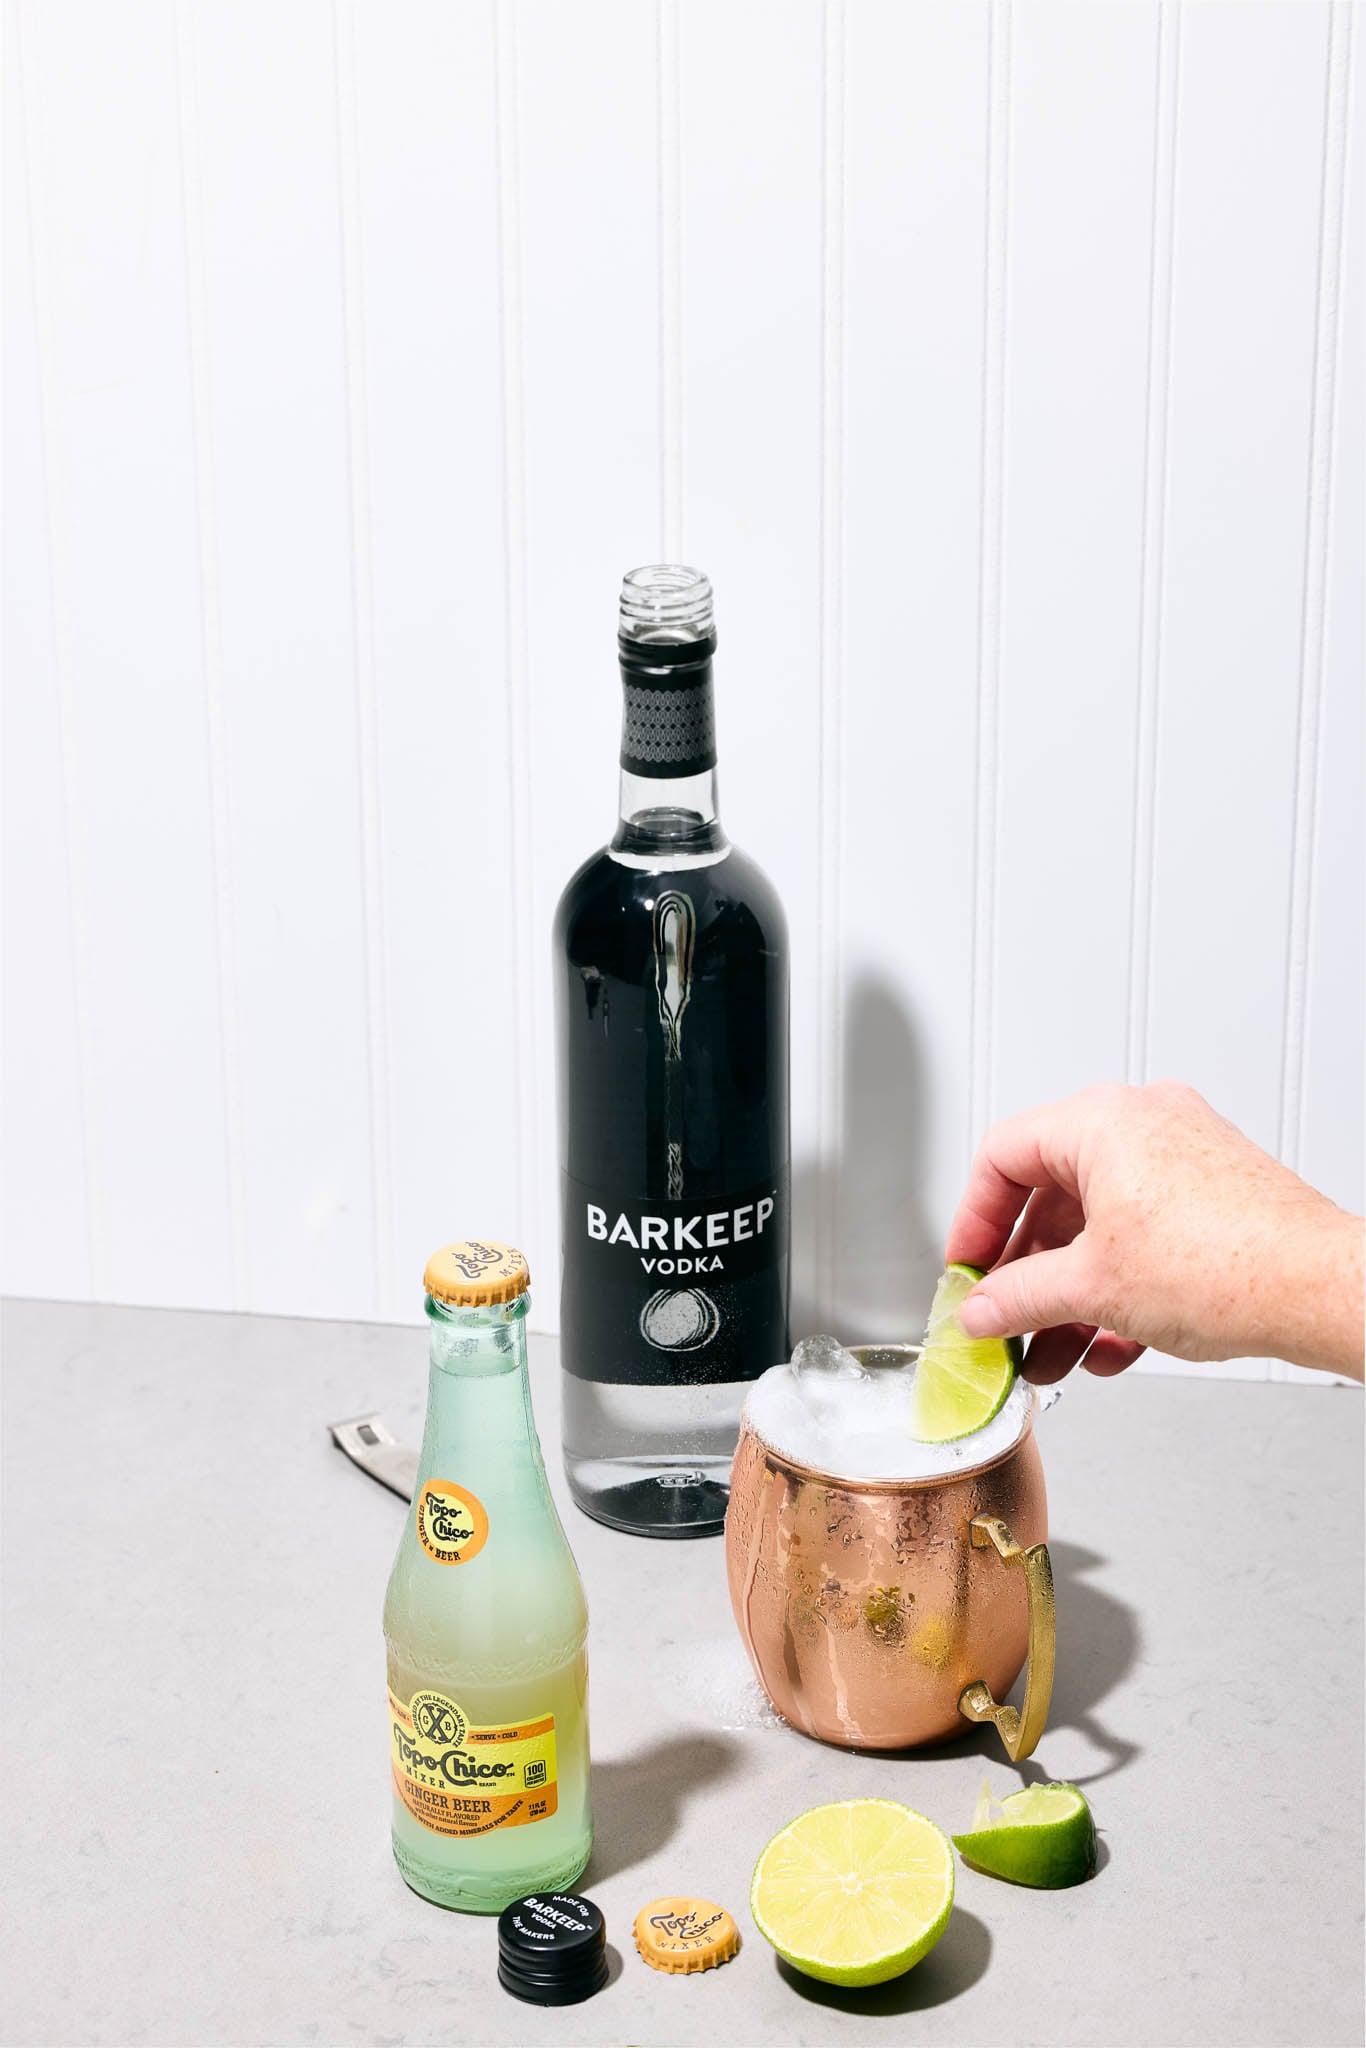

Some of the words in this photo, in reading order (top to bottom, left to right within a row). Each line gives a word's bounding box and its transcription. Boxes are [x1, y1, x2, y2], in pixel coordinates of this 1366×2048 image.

[586, 1196, 774, 1251] BARKEEP
[452, 1252, 488, 1279] Topo
[640, 1254, 724, 1275] VODKA
[425, 1492, 462, 1518] Topo
[418, 1504, 430, 1547] GINGER
[435, 1547, 461, 1561] BEER
[432, 1515, 474, 1541] Chico
[420, 1694, 432, 1702] THE
[433, 1695, 466, 1727] LEGENDARY
[453, 1729, 466, 1748] TASTE
[423, 1715, 429, 1724] G
[423, 1703, 451, 1743] X
[445, 1721, 452, 1731] B
[502, 1731, 518, 1739] COLD
[393, 1722, 441, 1771] Topo
[440, 1750, 514, 1786] Chico
[406, 1765, 446, 1789] MIXER
[527, 1763, 544, 1776] 100
[405, 1779, 449, 1809] GINGER
[452, 1798, 491, 1812] BEER
[412, 1798, 445, 1816] NATURALLY
[446, 1810, 480, 1820] FLAVORED
[418, 1815, 434, 1829] WITH
[435, 1825, 458, 1835] ADDED
[459, 1822, 494, 1836] MINERALS
[494, 1815, 507, 1826] FOR
[439, 1816, 458, 1825] natural
[459, 1819, 478, 1827] flavors
[523, 1897, 586, 1931] BARKEEP
[552, 1895, 580, 1906] MADE
[577, 1904, 590, 1917] FOR
[512, 1916, 523, 1929] THE
[519, 1927, 555, 1940] MAKERS
[531, 1912, 557, 1930] VODKA
[649, 1911, 697, 1936] Topo
[660, 1935, 715, 1950] MIXER
